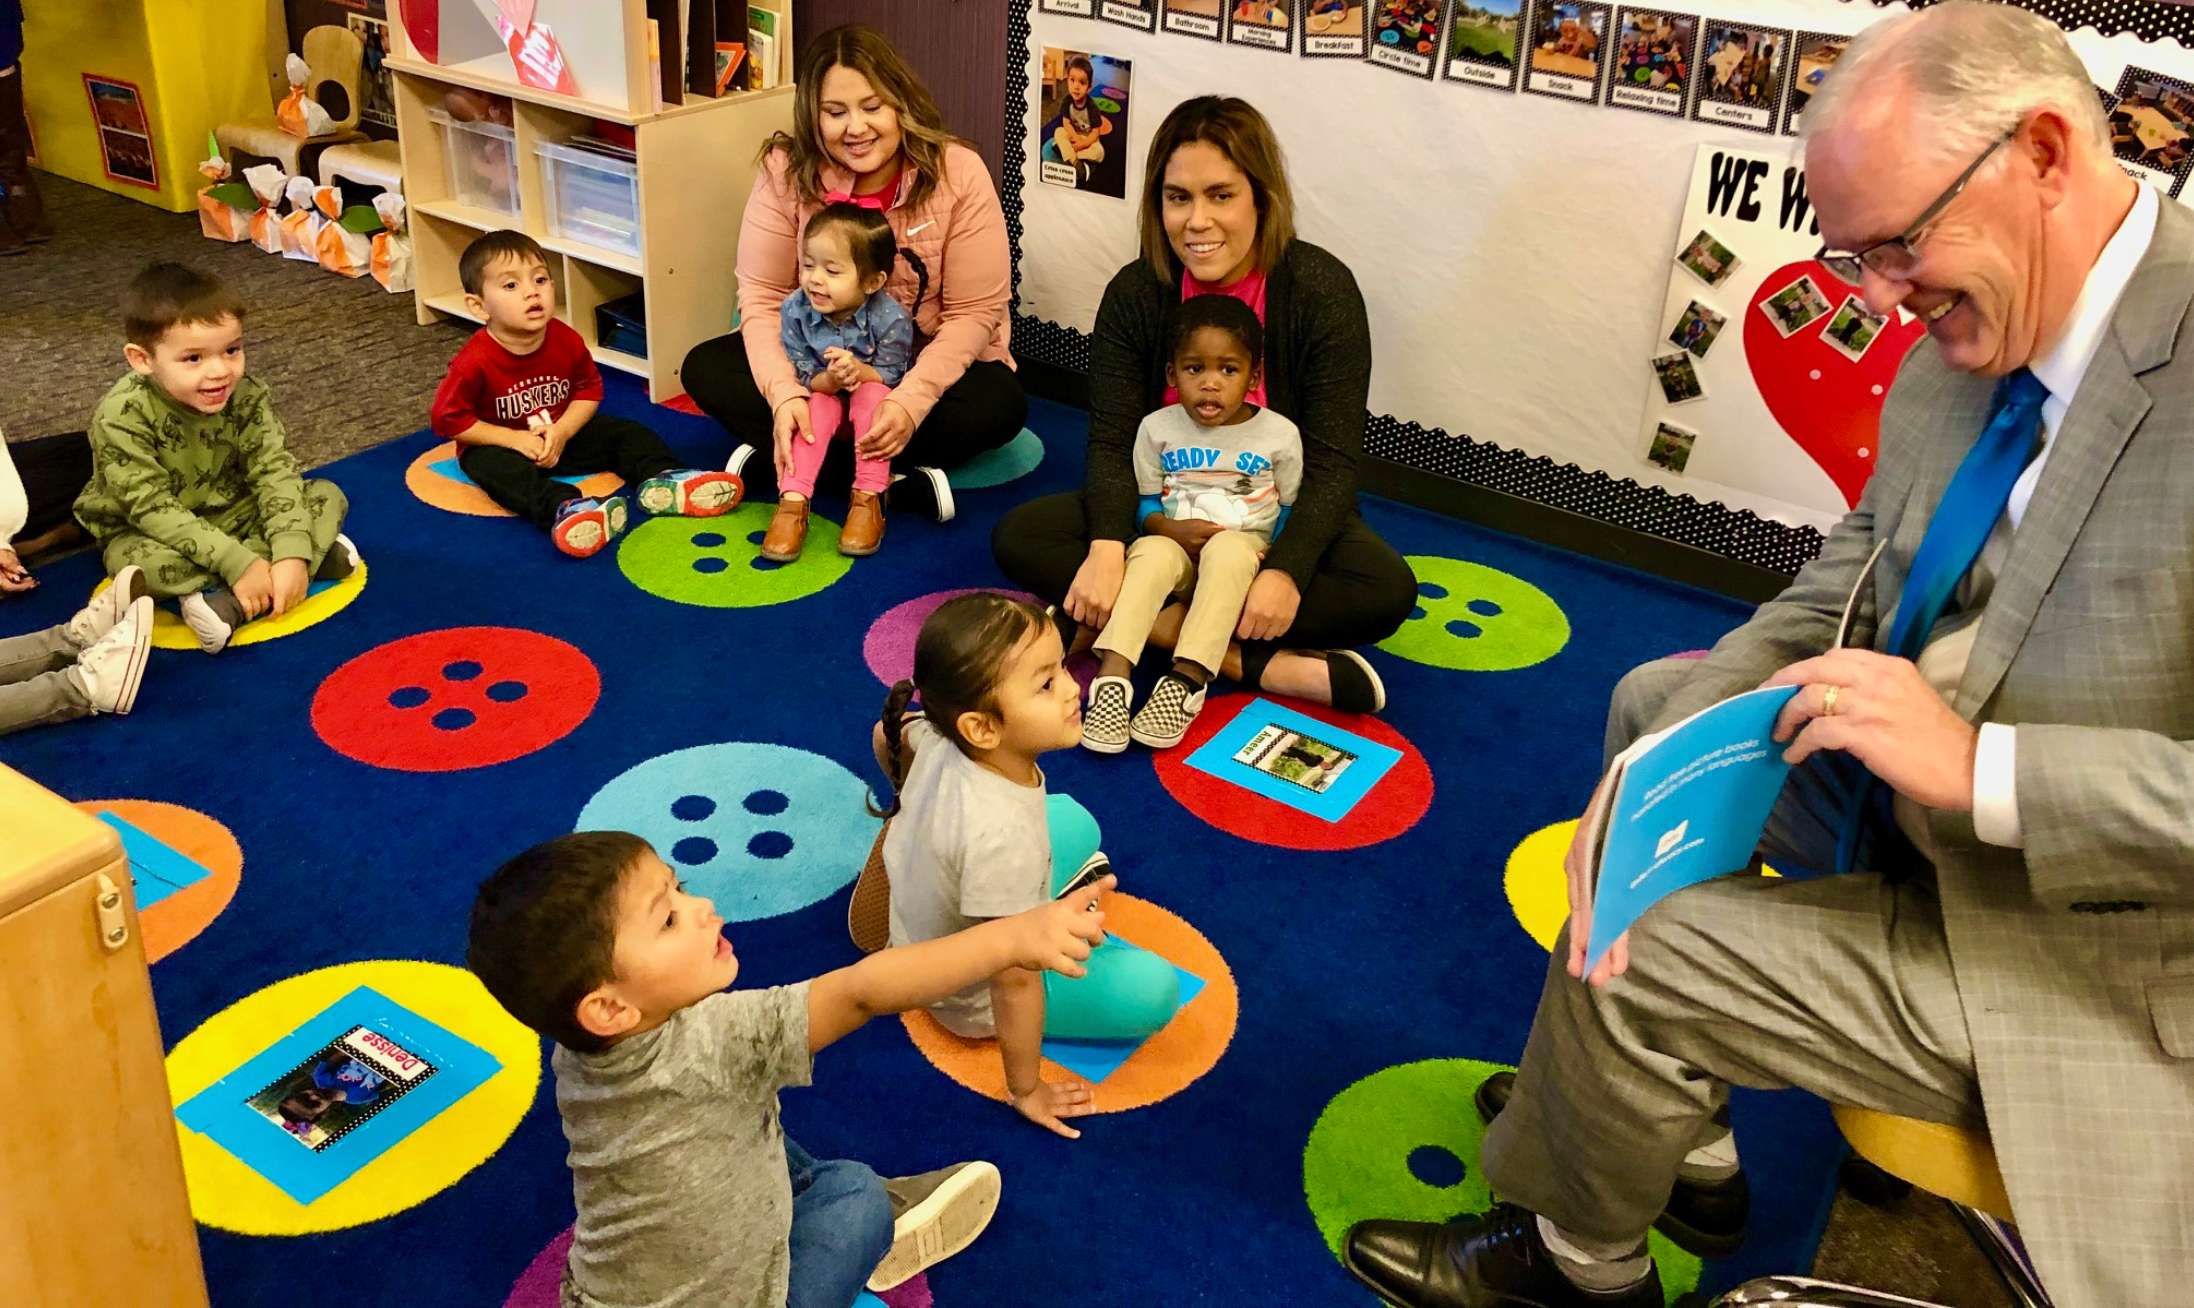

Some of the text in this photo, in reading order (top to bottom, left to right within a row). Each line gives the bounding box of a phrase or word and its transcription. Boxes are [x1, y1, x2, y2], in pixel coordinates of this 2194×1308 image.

[1107, 6, 1146, 23] Wash Hands
[1174, 17, 1210, 31] Bathroom
[1378, 49, 1421, 68] Circle time
[1463, 65, 1496, 79] Outside
[1547, 78, 1574, 91] Snack
[1615, 85, 1677, 107] Relaxing time
[1714, 105, 1753, 121] Centers
[1707, 151, 1769, 222] WE
[496, 379, 570, 420] HUSKERS
[1242, 730, 1272, 756] Ameer
[361, 1032, 419, 1071] Denisse
